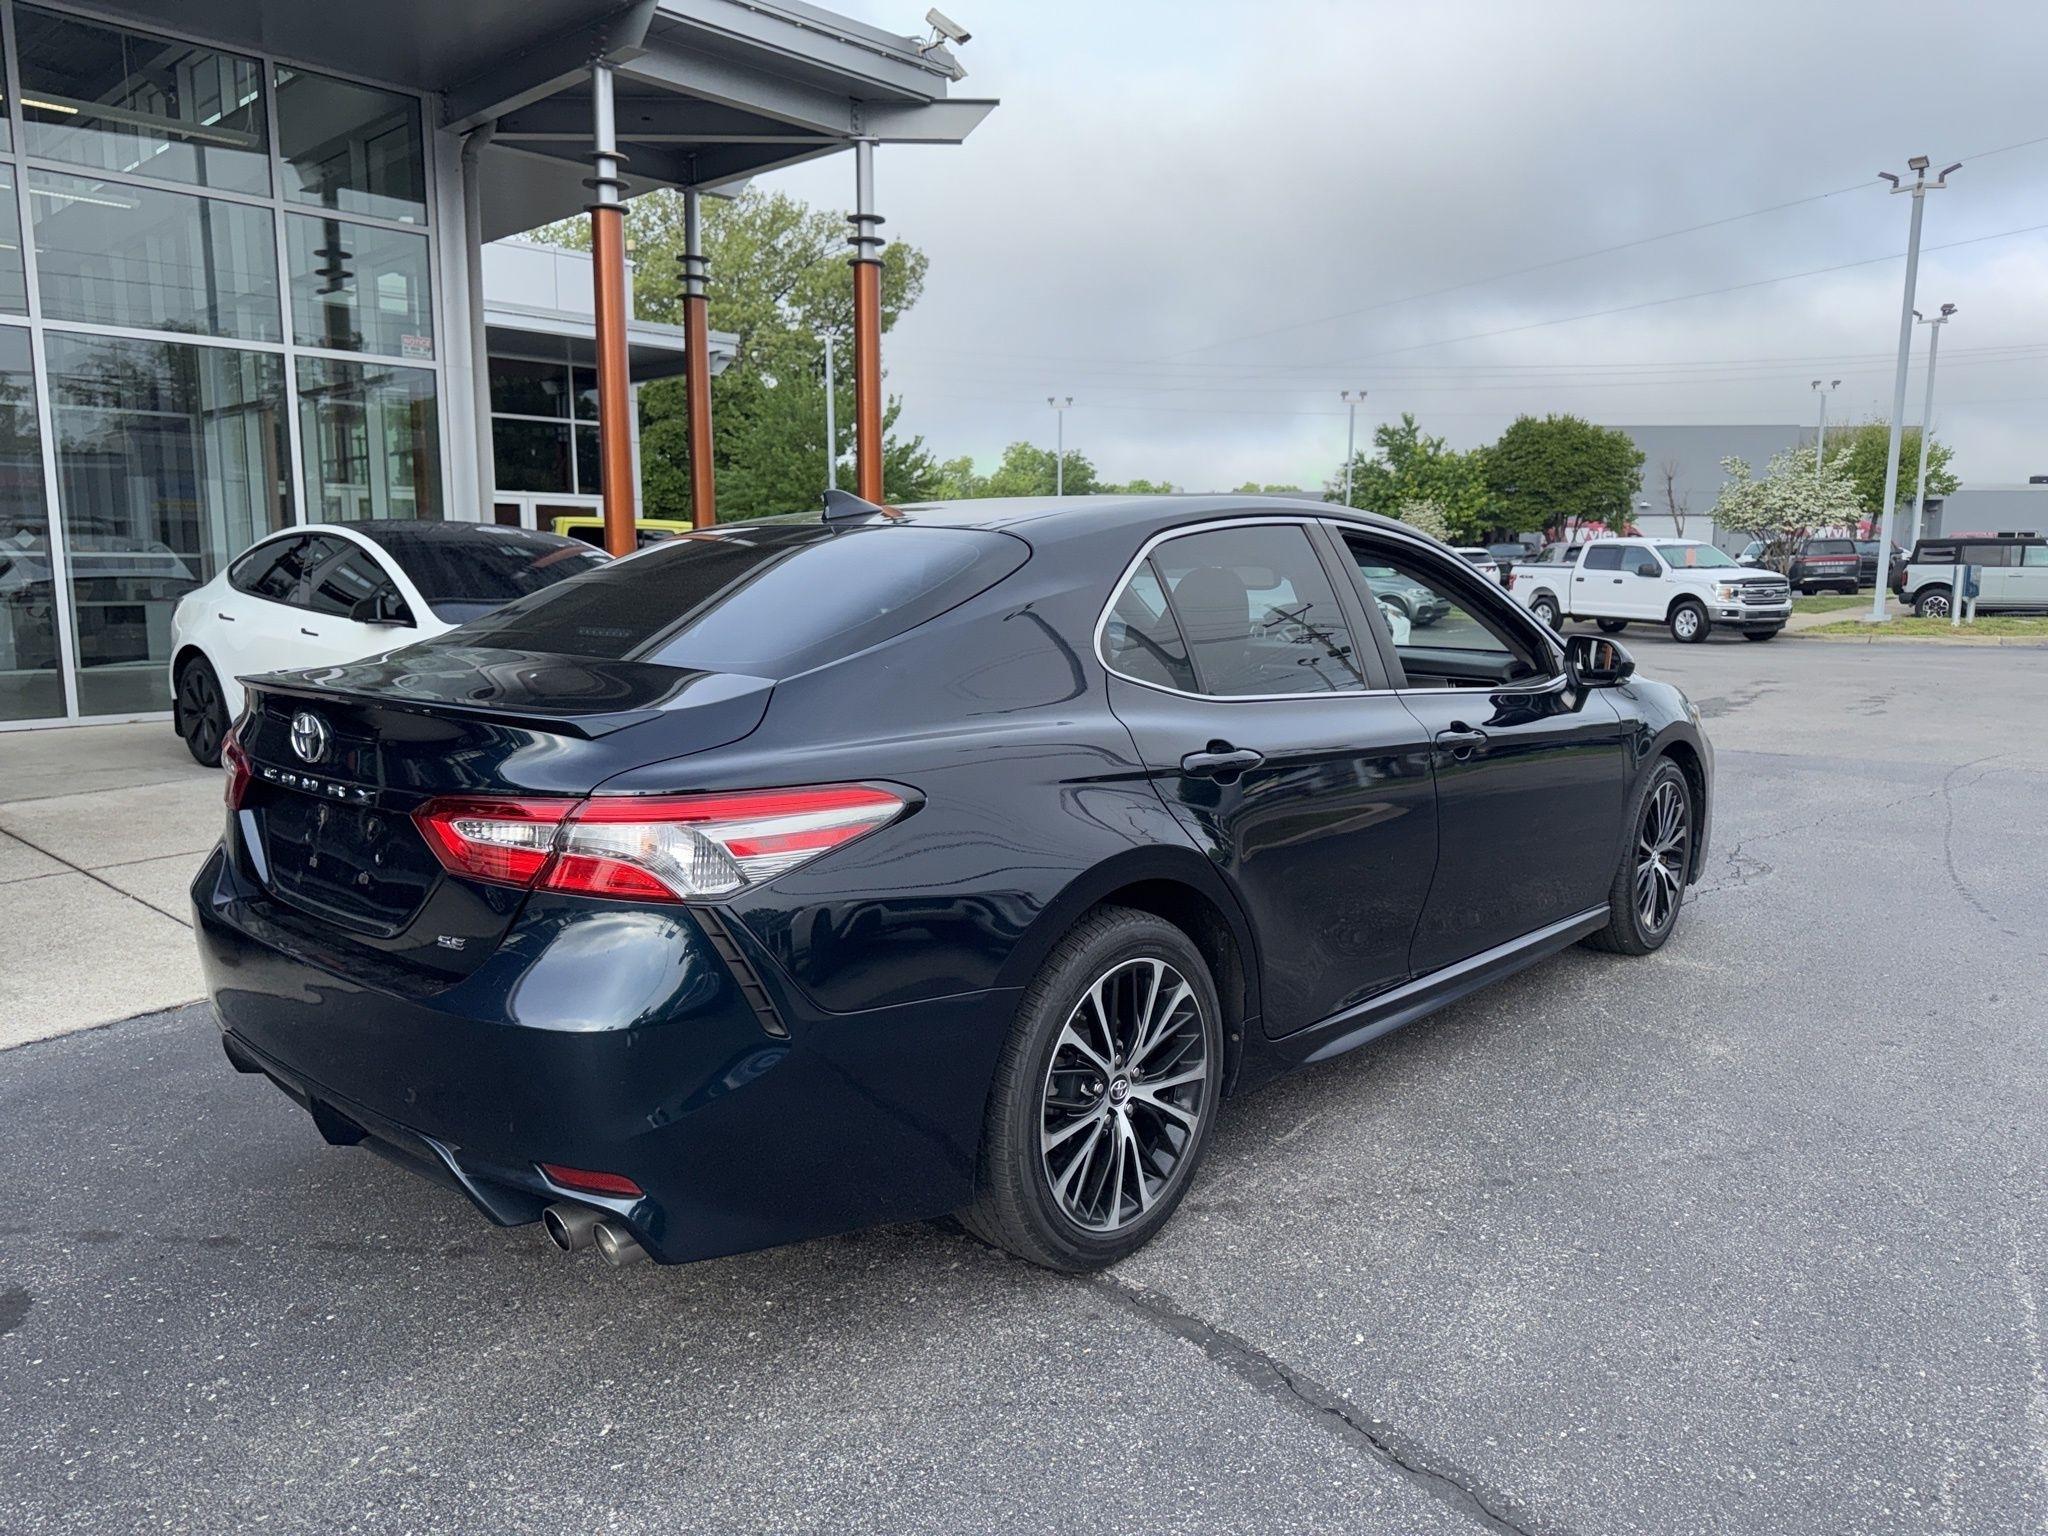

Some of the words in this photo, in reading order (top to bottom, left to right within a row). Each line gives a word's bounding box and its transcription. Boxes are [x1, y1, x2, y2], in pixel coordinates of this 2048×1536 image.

[1809, 525, 1865, 541] Wylr
[263, 767, 376, 804] CAMRY
[437, 934, 466, 951] SE
